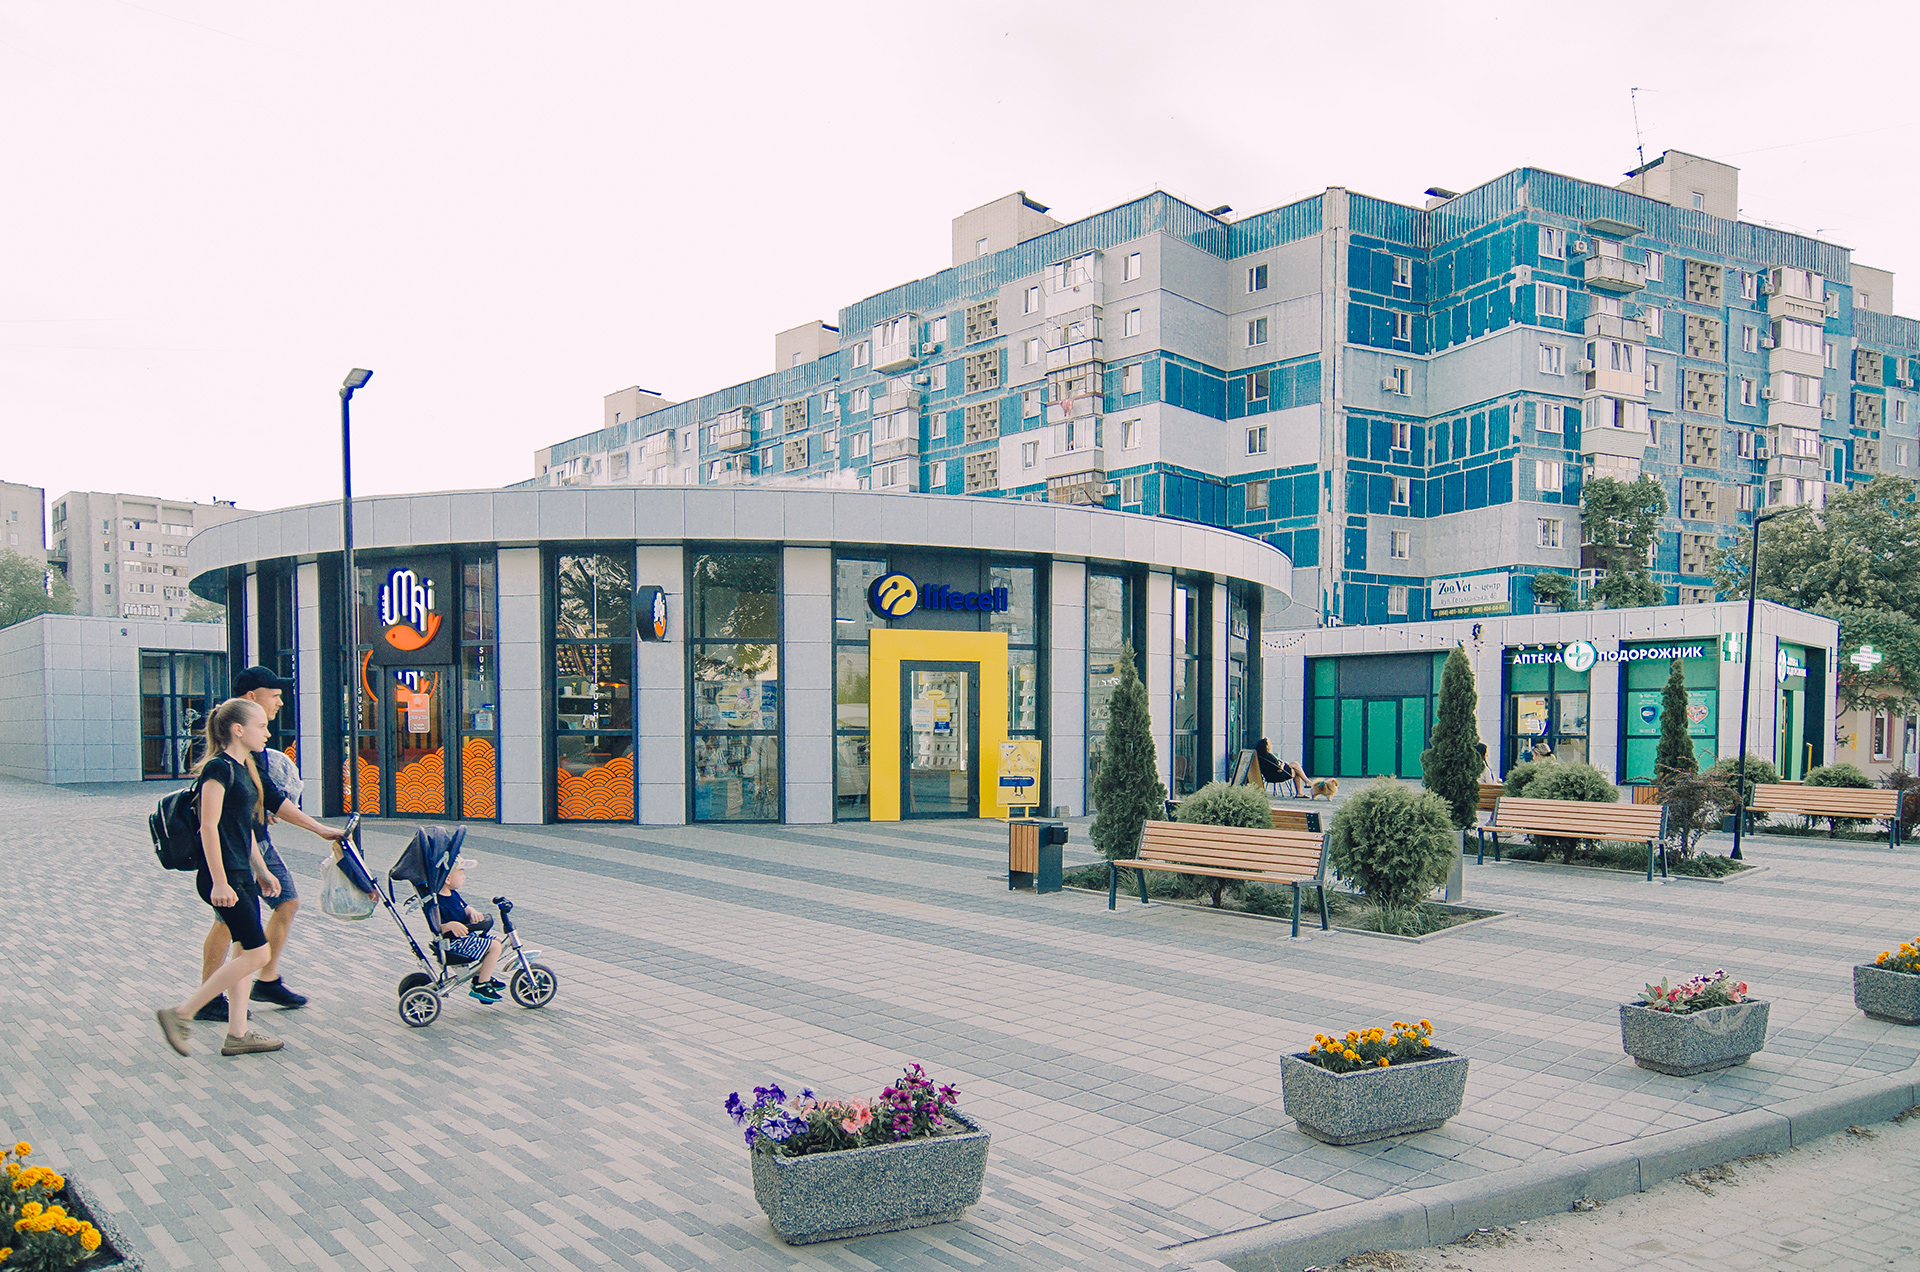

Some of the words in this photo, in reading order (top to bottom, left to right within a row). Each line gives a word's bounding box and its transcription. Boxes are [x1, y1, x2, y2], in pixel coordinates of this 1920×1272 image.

[923, 583, 1008, 612] lifecell
[1513, 653, 1563, 665] АПТЕКА
[1598, 646, 1703, 663] ПОДОРОЖНИК
